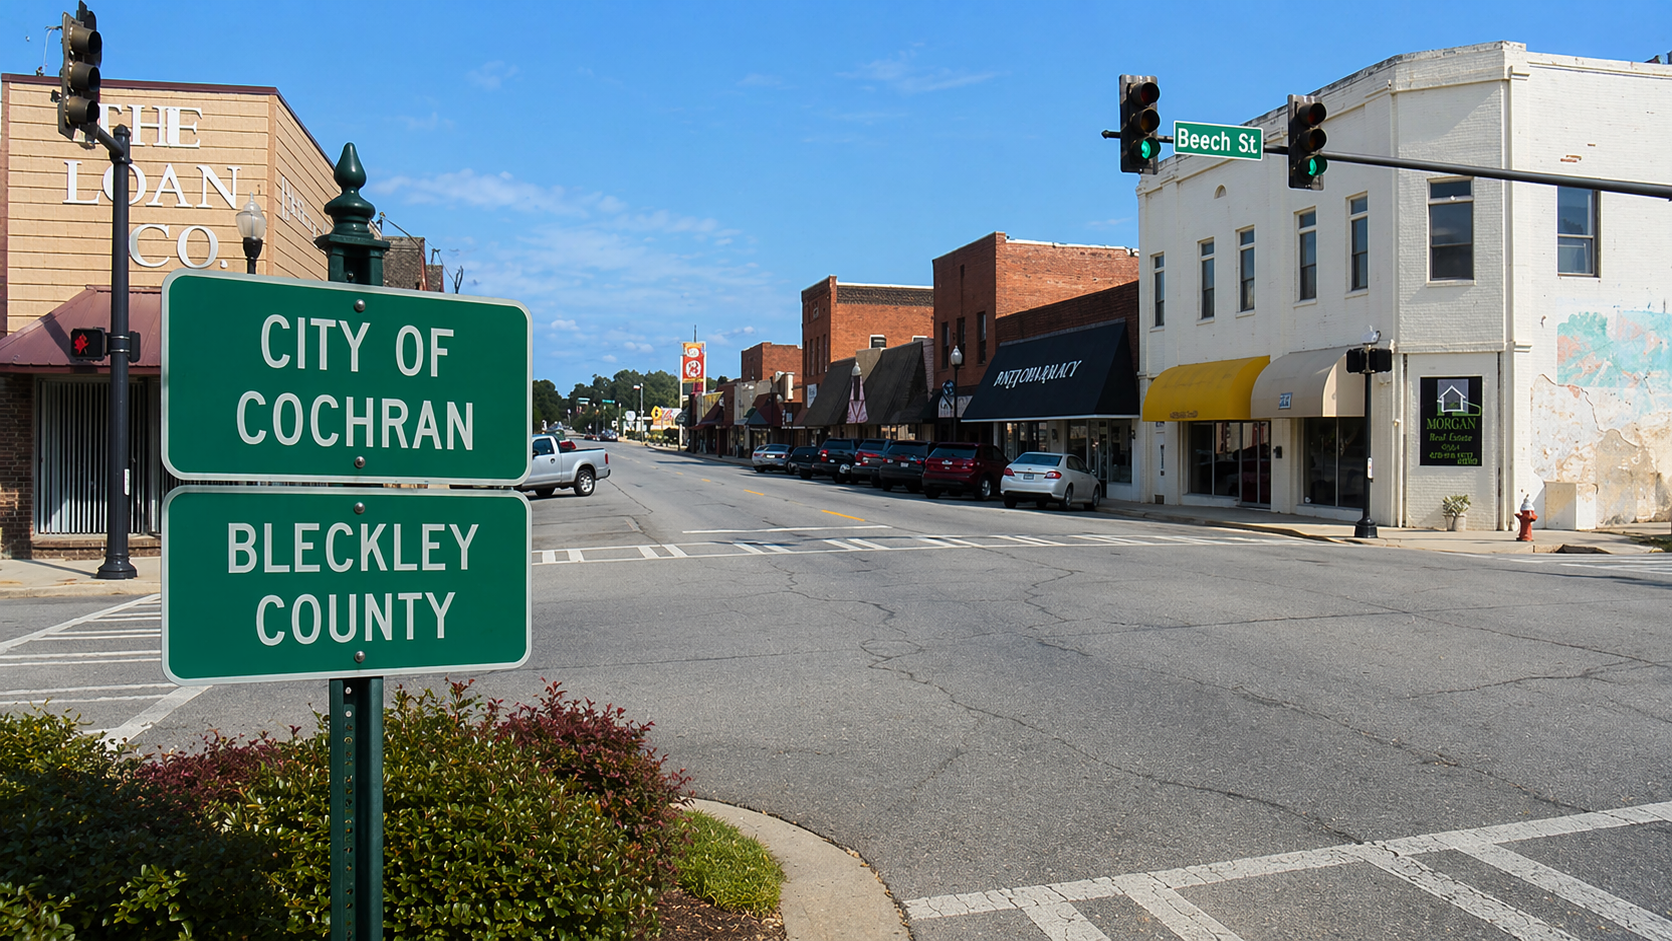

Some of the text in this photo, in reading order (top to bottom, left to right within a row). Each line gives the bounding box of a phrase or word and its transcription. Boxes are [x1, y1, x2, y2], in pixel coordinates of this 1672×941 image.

[1177, 127, 1231, 152] Beech
[63, 160, 242, 210] LOAN
[128, 223, 228, 269] CO.
[260, 313, 455, 378] CITY OF
[236, 389, 475, 451] COCHRAN
[1426, 417, 1476, 430] MORGAN
[227, 522, 480, 574] BLECKLEY
[255, 591, 456, 646] COUNTY
